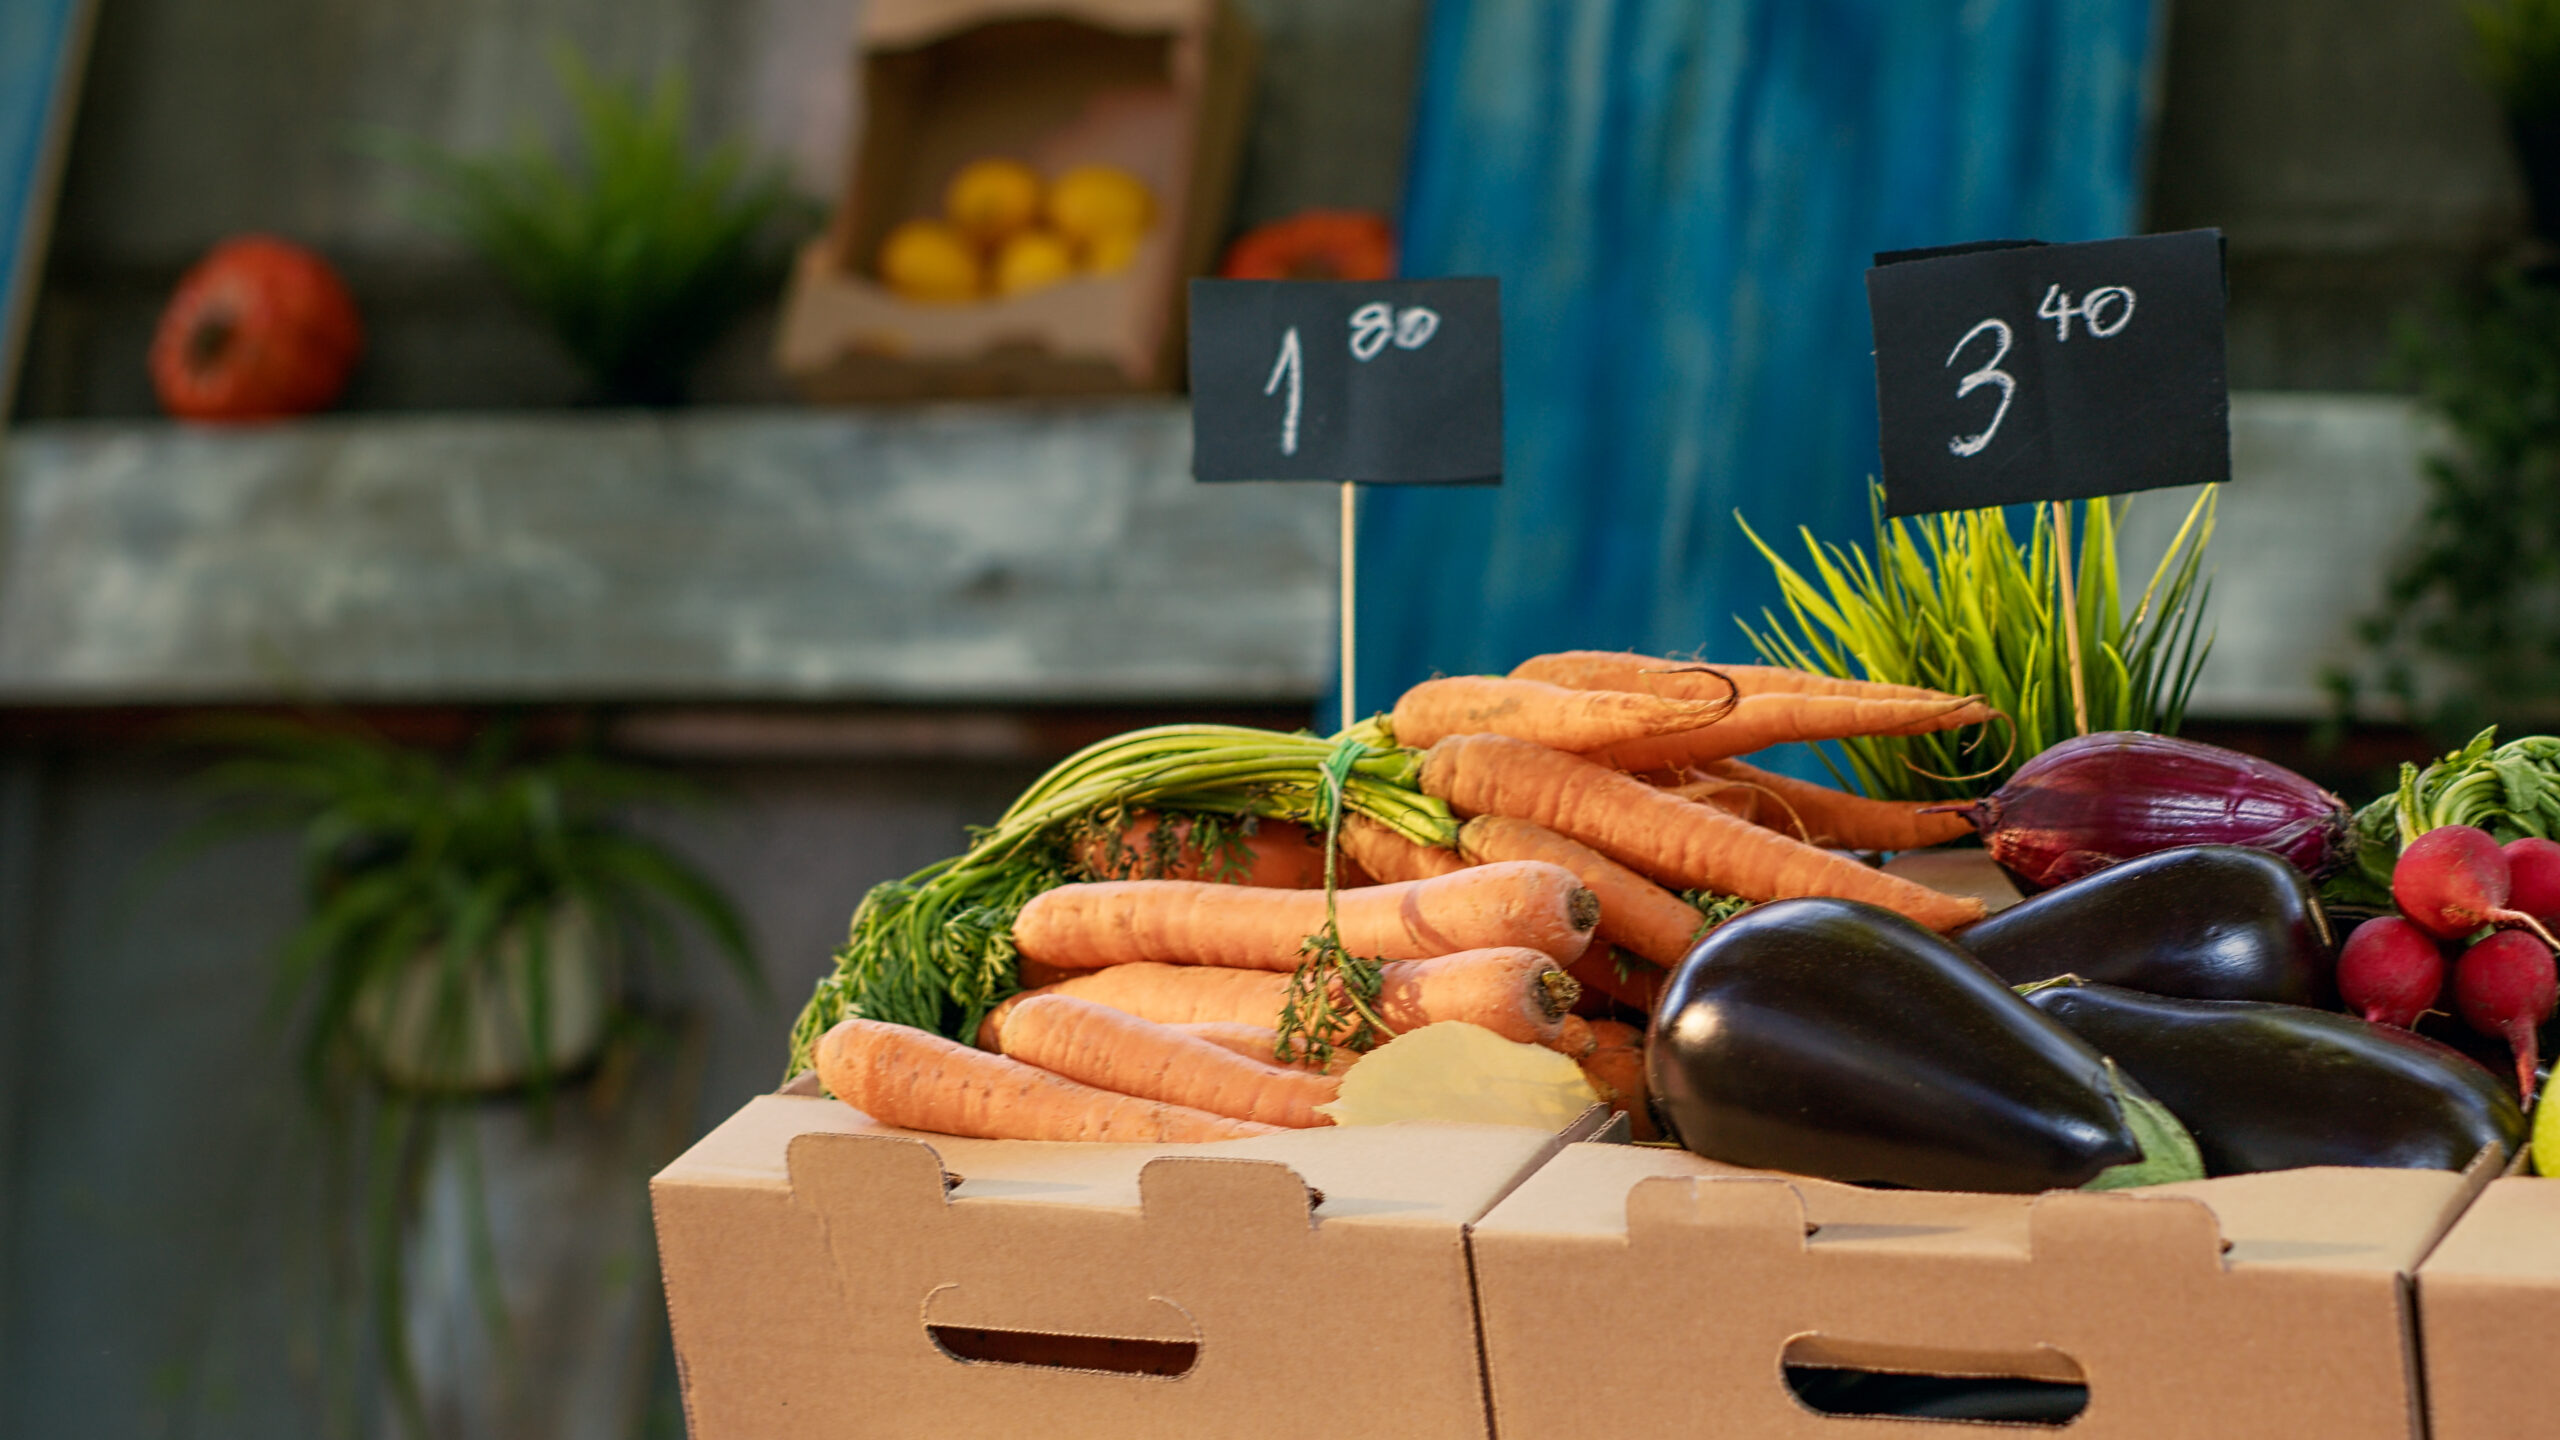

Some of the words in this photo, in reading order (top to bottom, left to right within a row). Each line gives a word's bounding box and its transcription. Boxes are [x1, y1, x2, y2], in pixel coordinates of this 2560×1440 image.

[1264, 326, 1302, 455] 1
[1349, 302, 1440, 361] 80
[1945, 318, 2016, 457] 3
[2037, 283, 2136, 341] 40
